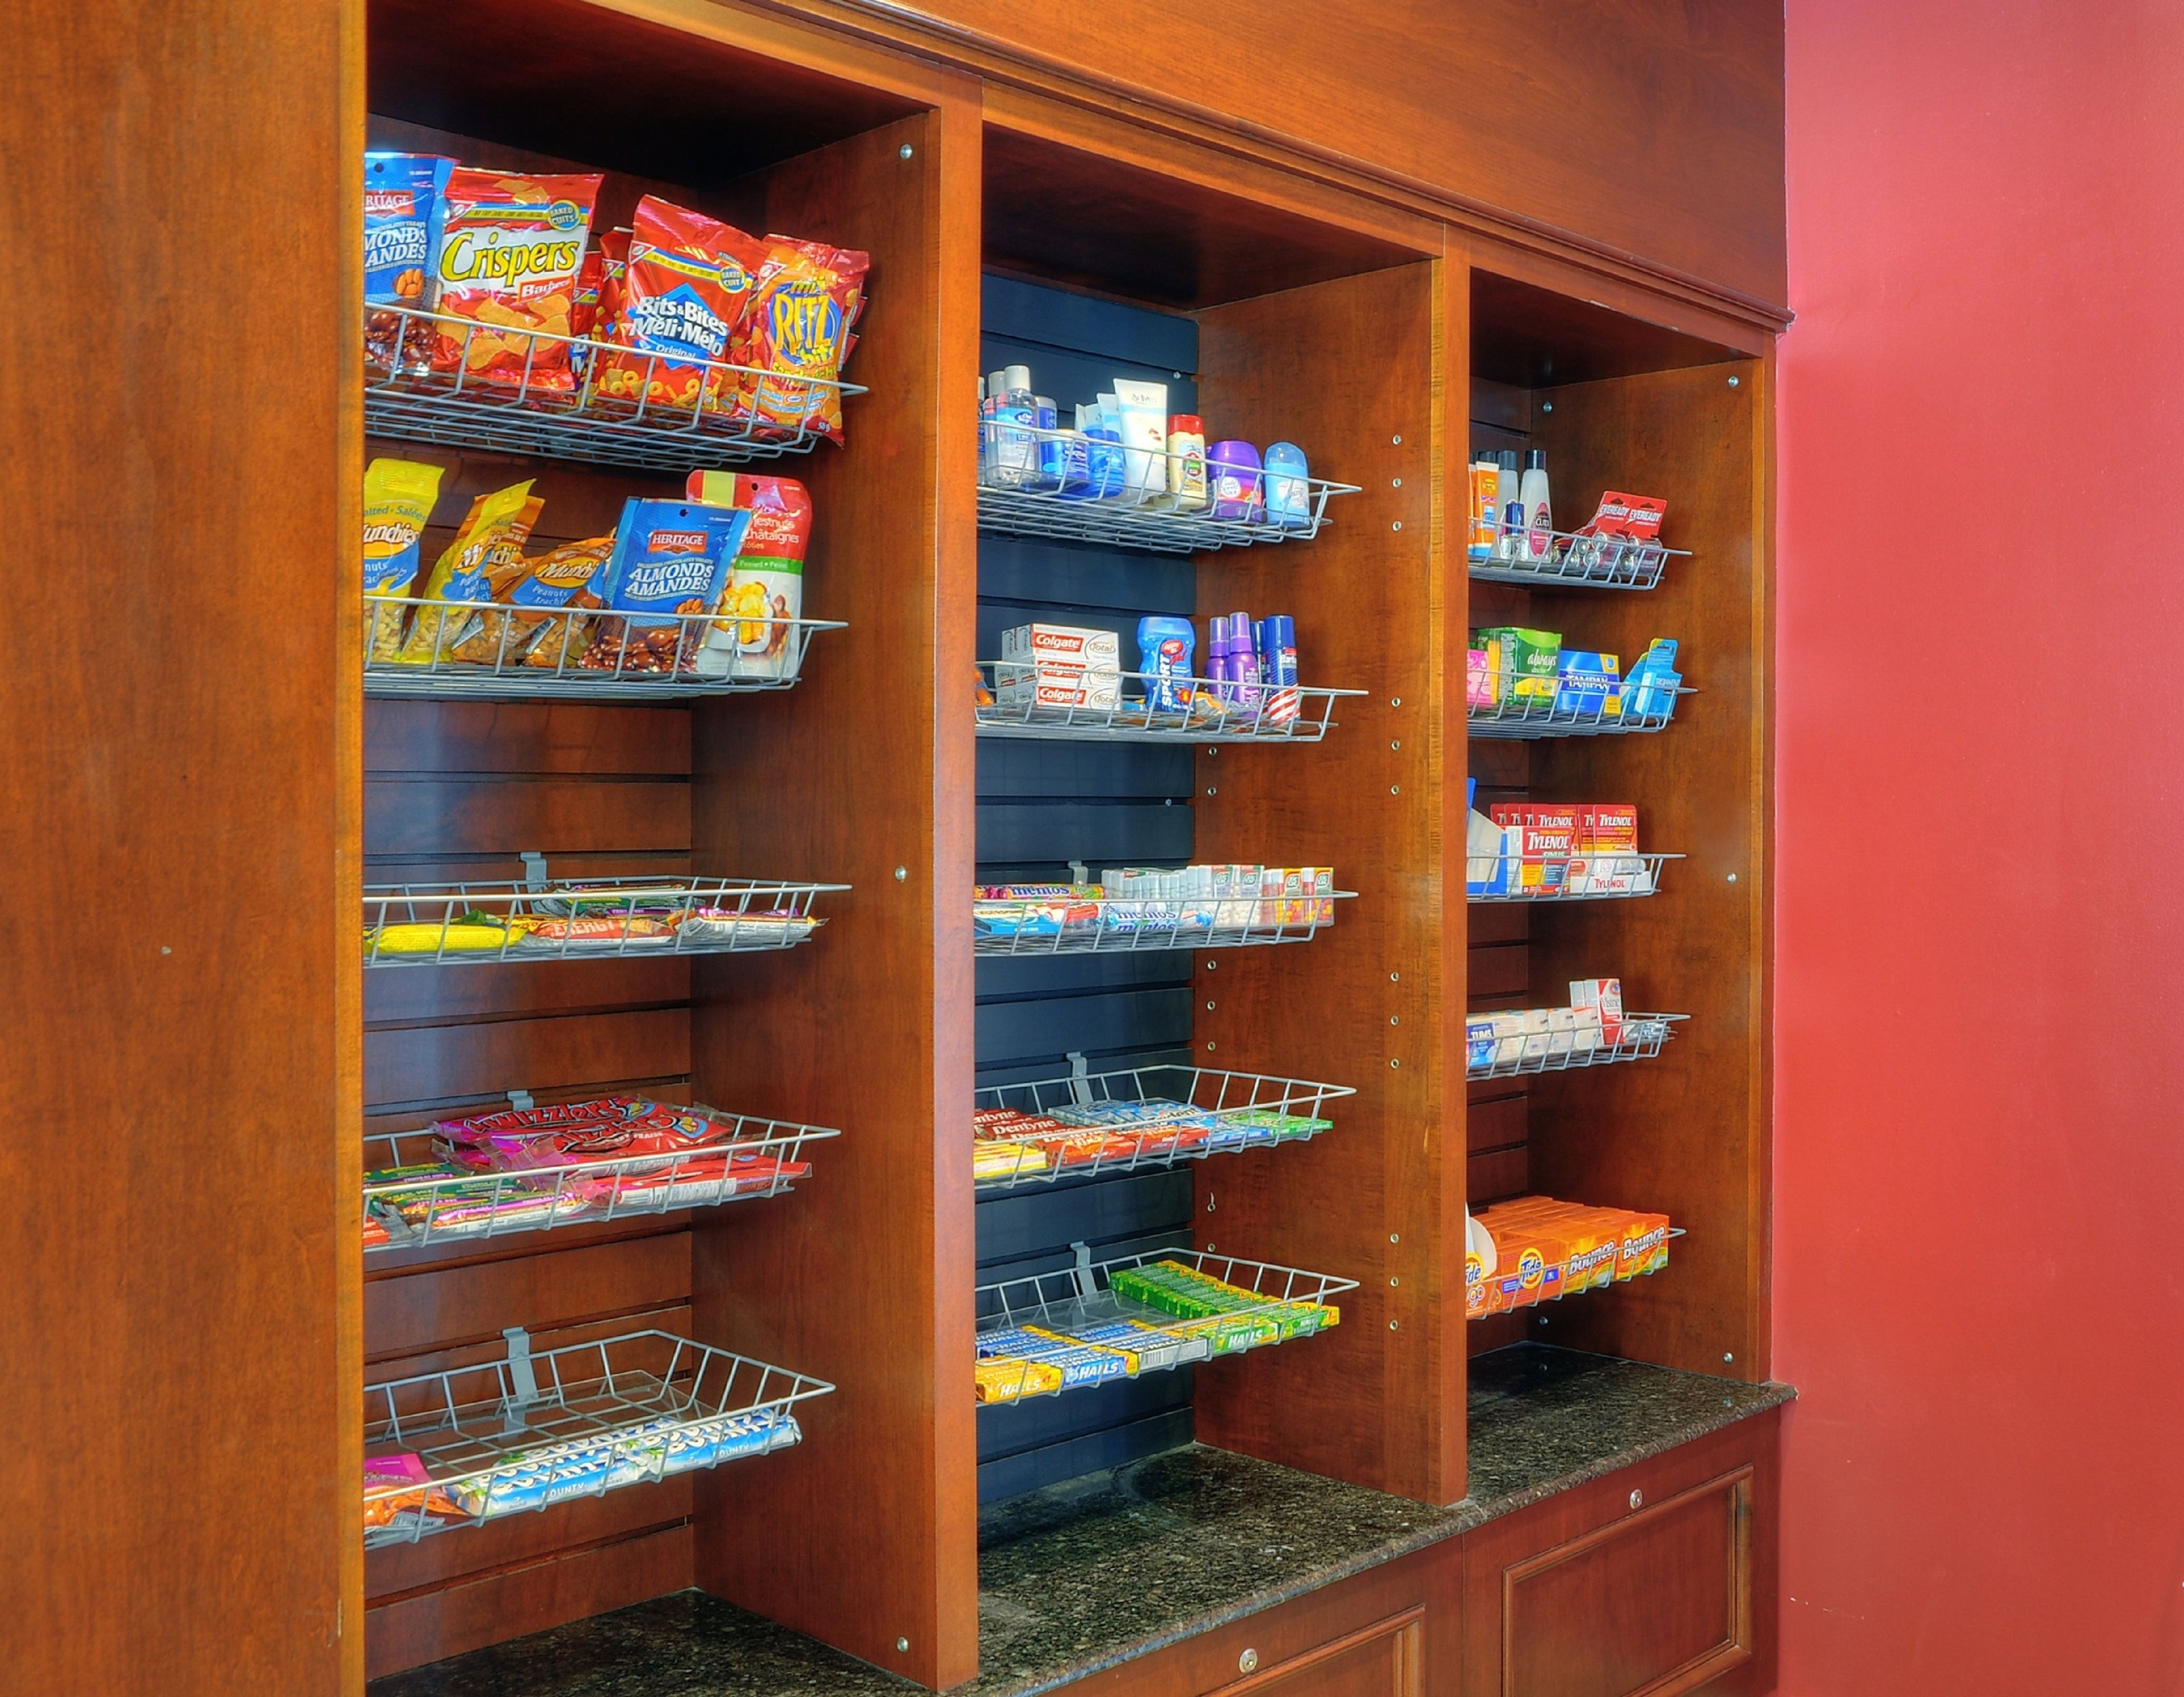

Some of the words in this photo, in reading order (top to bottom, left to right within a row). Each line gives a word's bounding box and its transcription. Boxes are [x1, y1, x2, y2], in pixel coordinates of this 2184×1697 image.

[365, 244, 427, 268] ANDES
[442, 231, 580, 288] Crispers
[774, 293, 833, 355] RITZ
[656, 344, 697, 359] Original
[395, 506, 427, 521] Salées
[752, 515, 795, 529] estnuts
[363, 521, 420, 543] unchies
[652, 533, 704, 545] HERITAGE
[628, 562, 715, 582] ALMONDS
[532, 585, 568, 597] Peanuts
[625, 577, 711, 596] AMANDES
[1035, 634, 1081, 649] Colgate
[1090, 642, 1115, 652] Total
[1527, 648, 1557, 672] always
[1566, 674, 1608, 690] TAMPAX
[1538, 814, 1573, 827] TYLENOL
[1599, 814, 1633, 827] TYLENOL
[1527, 831, 1569, 851] TYLENOL
[1011, 885, 1070, 896] mentos
[992, 1119, 1057, 1135] Dentyne
[1624, 1226, 1666, 1260] Bounce
[1569, 1241, 1615, 1276] Bounce
[1521, 1258, 1541, 1283] Tide
[1078, 1361, 1119, 1380] HALLS
[712, 1443, 751, 1458] OUNTY
[541, 1481, 585, 1498] OUNTY
